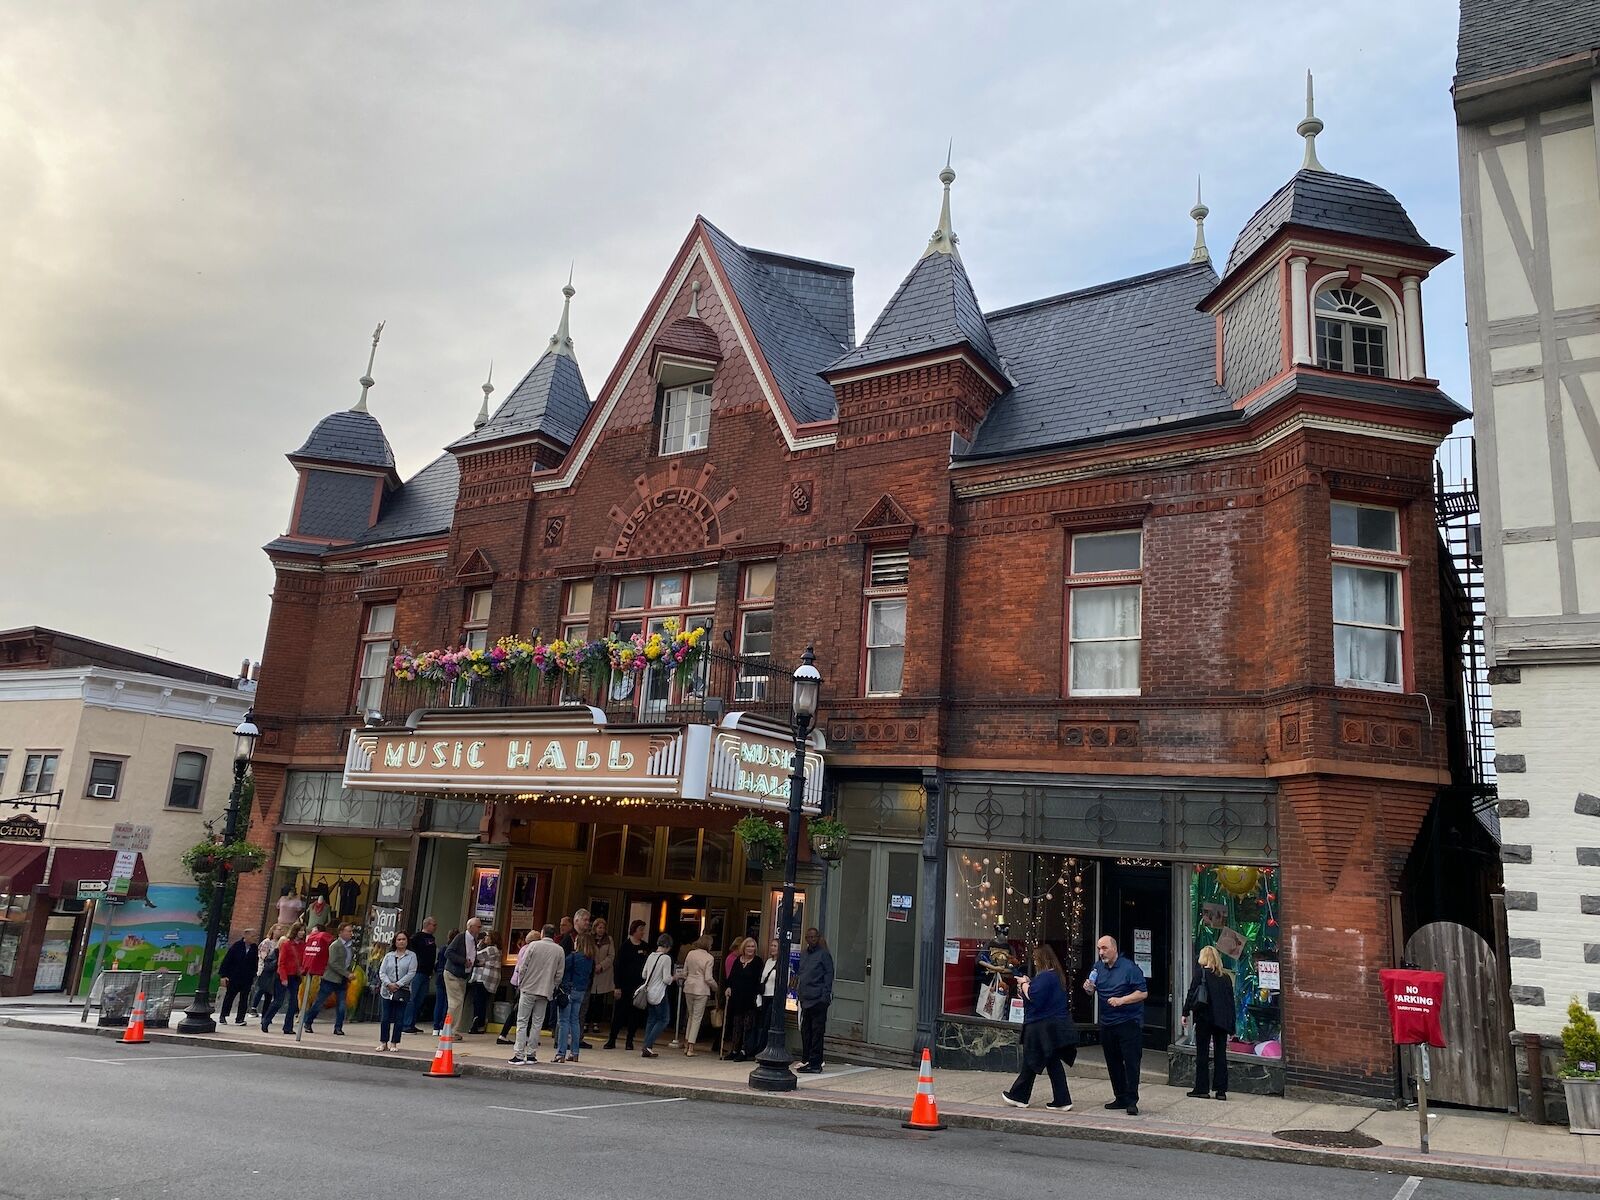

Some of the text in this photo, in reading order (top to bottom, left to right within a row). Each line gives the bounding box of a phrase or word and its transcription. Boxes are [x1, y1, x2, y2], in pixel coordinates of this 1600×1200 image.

[791, 485, 809, 511] 1885
[384, 740, 635, 771] MUSIC HALL
[0, 825, 41, 837] CHINA
[376, 909, 396, 928] Yarn
[373, 926, 395, 946] Shop
[1406, 985, 1419, 994] NO
[1394, 995, 1433, 1005] PARKING
